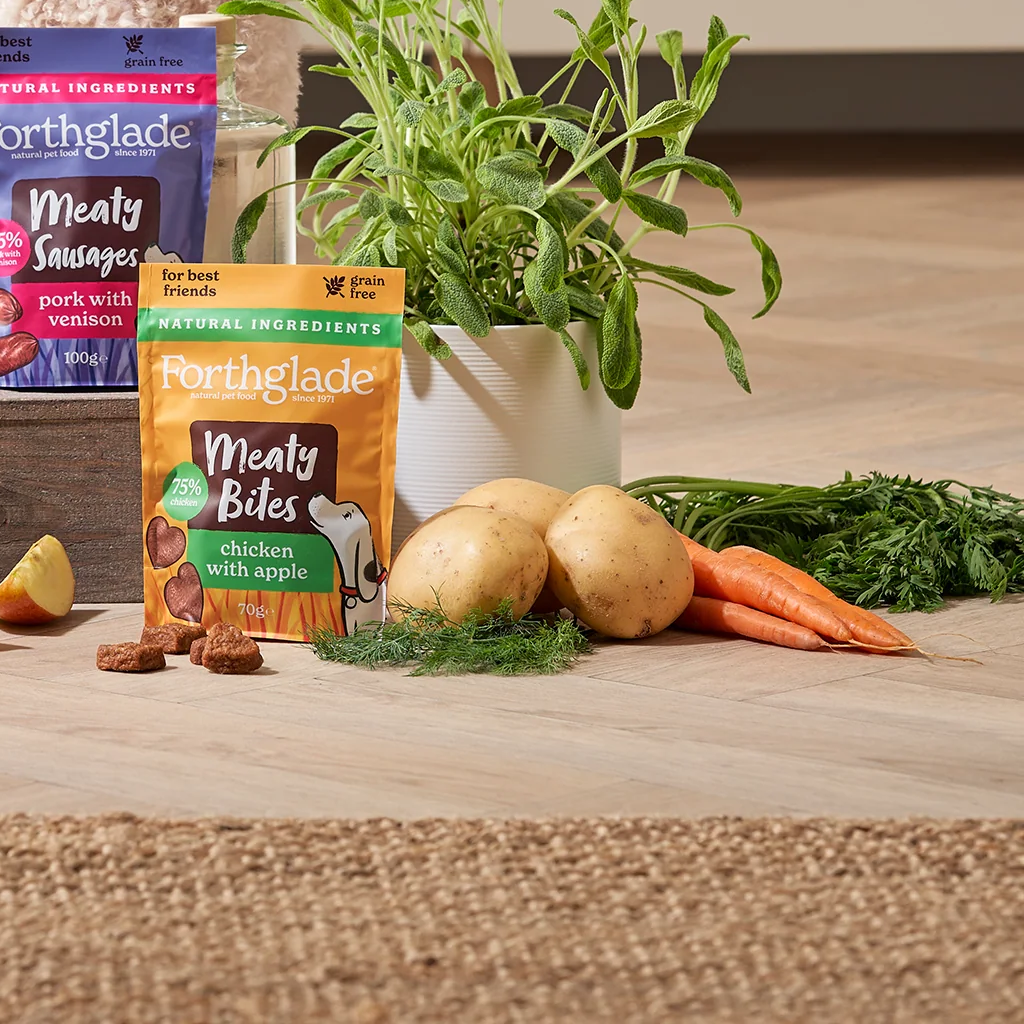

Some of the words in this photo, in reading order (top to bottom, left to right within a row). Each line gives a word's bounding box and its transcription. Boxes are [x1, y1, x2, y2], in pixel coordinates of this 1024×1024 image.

[0, 36, 32, 47] best
[125, 59, 156, 68] grain
[160, 56, 183, 67] free
[69, 83, 196, 94] INGREDIENTS
[11, 150, 42, 160] natural
[44, 150, 58, 159] pet
[60, 149, 79, 157] food
[115, 149, 137, 157] since
[139, 149, 156, 157] 1971
[30, 186, 142, 232] Meaty
[5, 250, 21, 258] with
[32, 233, 139, 277] Sausages
[162, 269, 184, 281] for
[188, 270, 219, 281] best
[350, 275, 385, 287] grain
[164, 285, 217, 297] friends
[350, 288, 376, 299] free
[39, 292, 85, 310] pork
[88, 291, 132, 306] with
[48, 312, 123, 326] venison
[159, 319, 243, 329] NATURAL
[252, 319, 381, 335] INGREDIENTS
[161, 354, 374, 405] Forthglade
[190, 391, 220, 400] natural
[221, 392, 235, 401] pet
[237, 391, 256, 400] food
[317, 395, 334, 403] 1971
[204, 430, 319, 481] Meaty
[171, 478, 201, 496] 75%
[170, 498, 198, 507] chicken
[217, 477, 299, 522] Bites
[221, 540, 294, 558] chicken
[206, 561, 249, 577] with
[254, 563, 308, 582] apple
